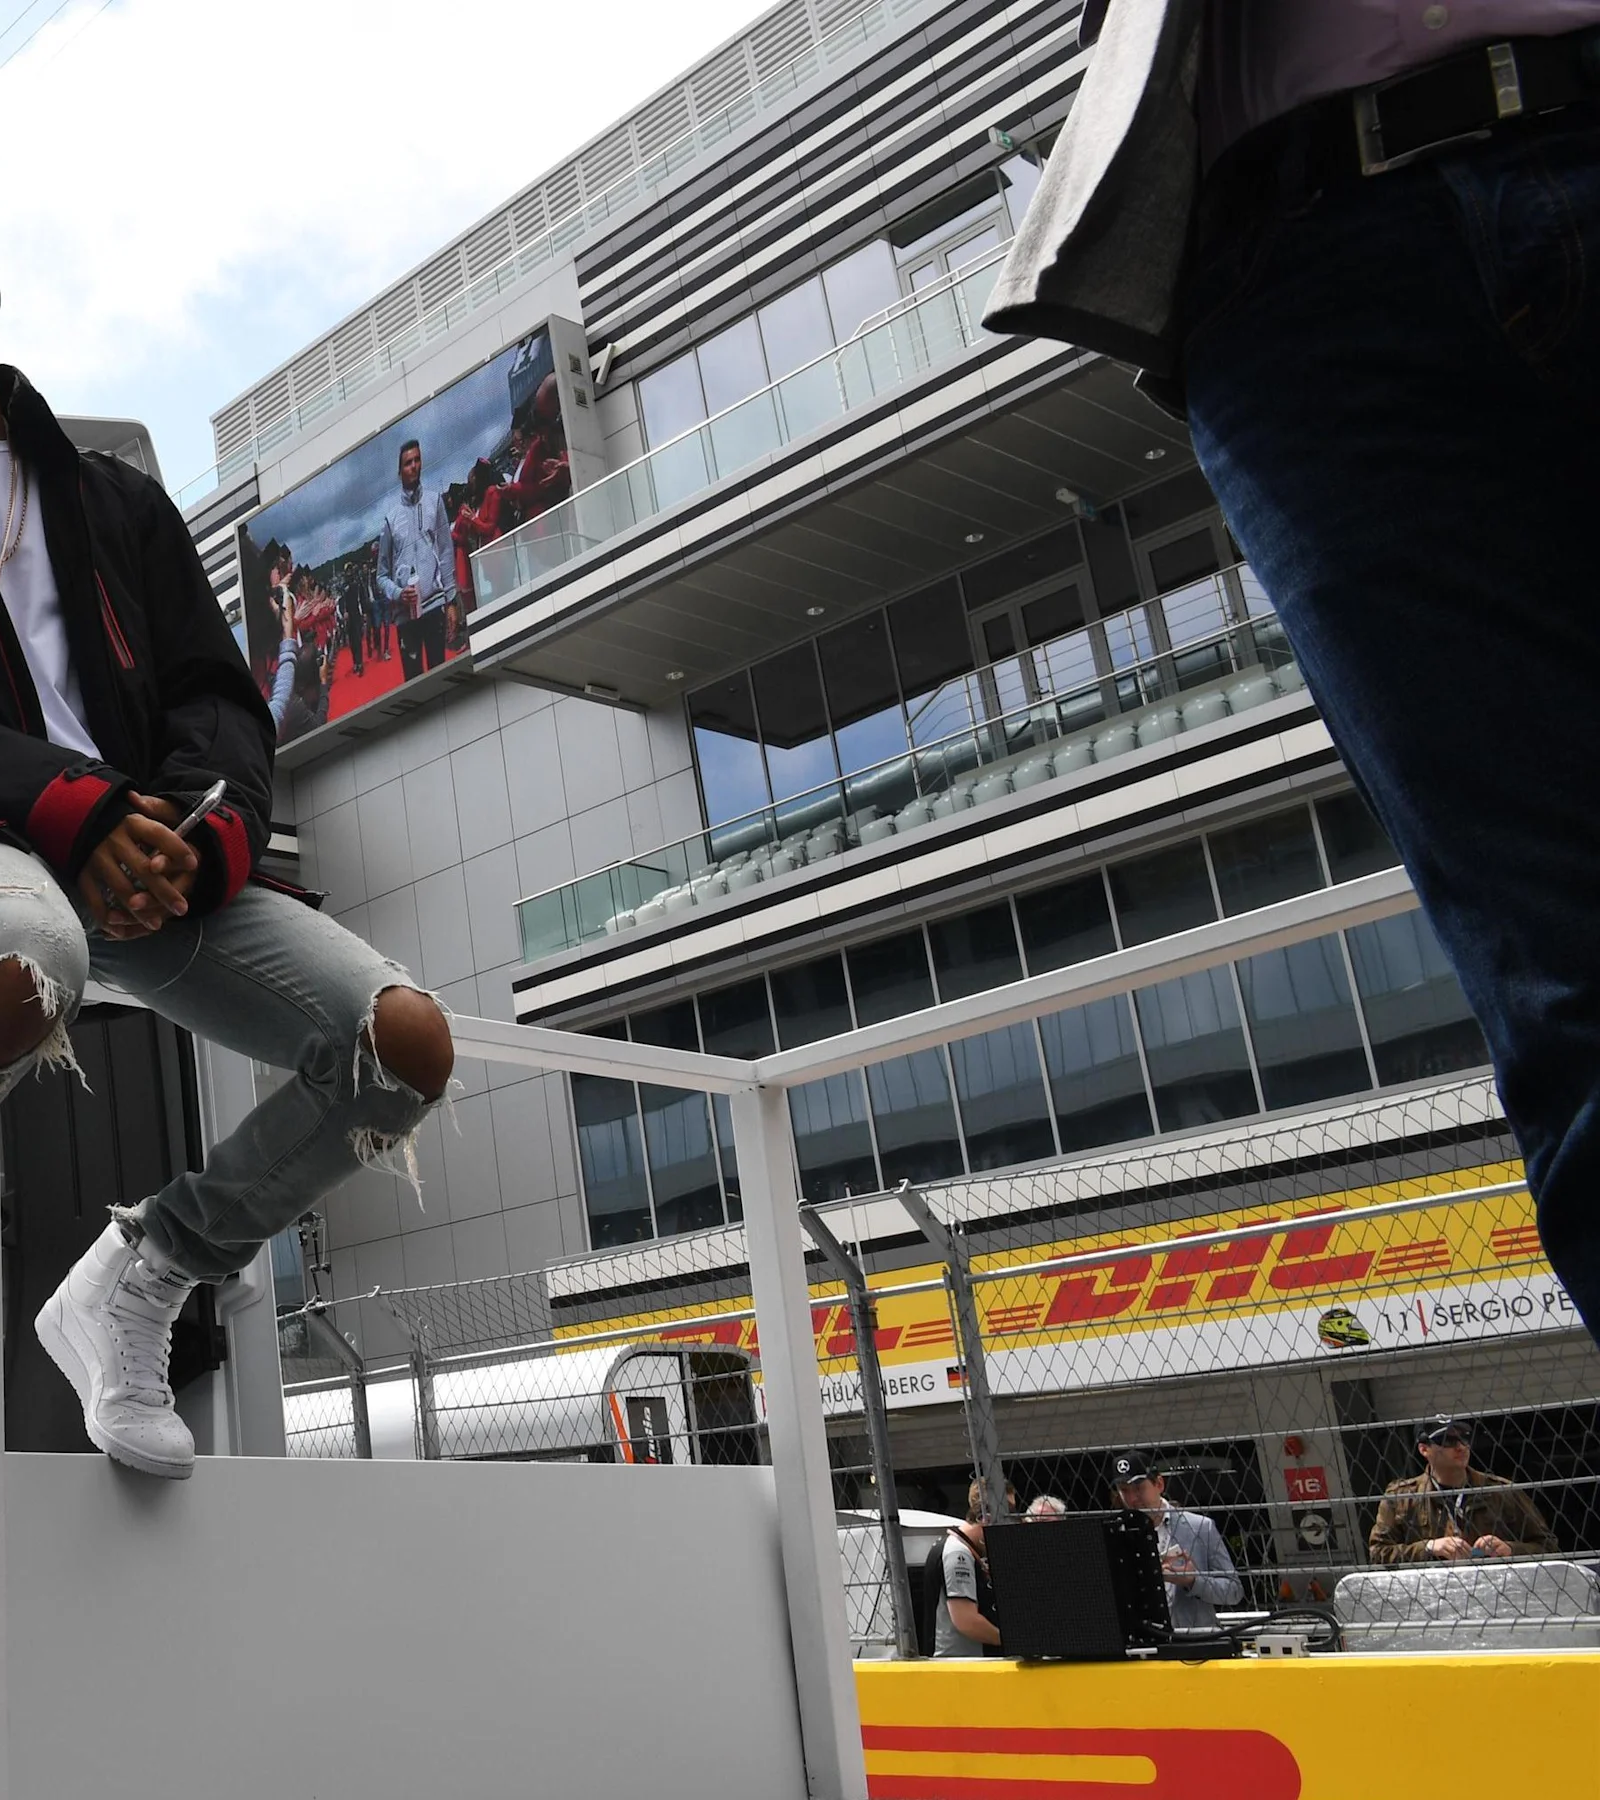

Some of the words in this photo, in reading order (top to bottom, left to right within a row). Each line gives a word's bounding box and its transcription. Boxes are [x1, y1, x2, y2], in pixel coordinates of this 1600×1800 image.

[1039, 1205, 1377, 1326] DHL
[1384, 1311, 1410, 1334] 11
[1434, 1295, 1534, 1327] SERGIO
[820, 1373, 936, 1405] HÜLKNBERG
[1294, 1478, 1321, 1494] 16
